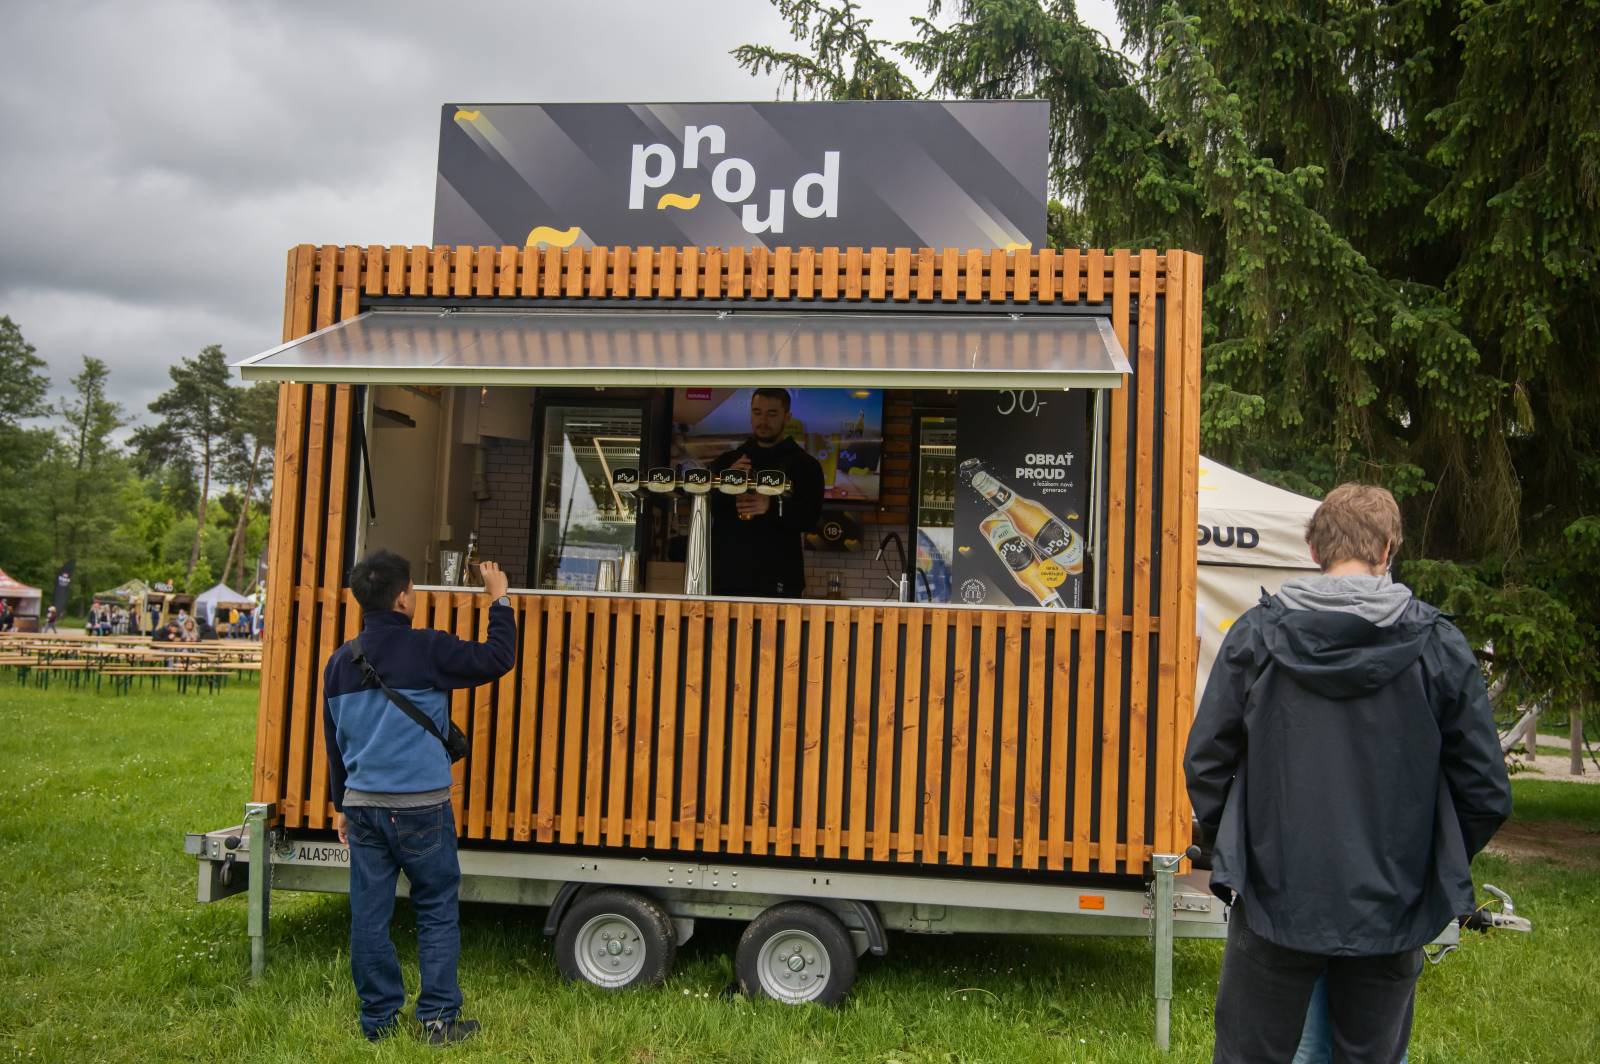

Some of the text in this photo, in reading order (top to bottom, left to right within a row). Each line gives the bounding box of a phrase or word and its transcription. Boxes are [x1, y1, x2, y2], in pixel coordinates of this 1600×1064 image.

[628, 124, 840, 234] proud
[1025, 452, 1074, 465] OBRAŤ
[1015, 467, 1066, 480] PROUD
[1044, 525, 1070, 556] proud
